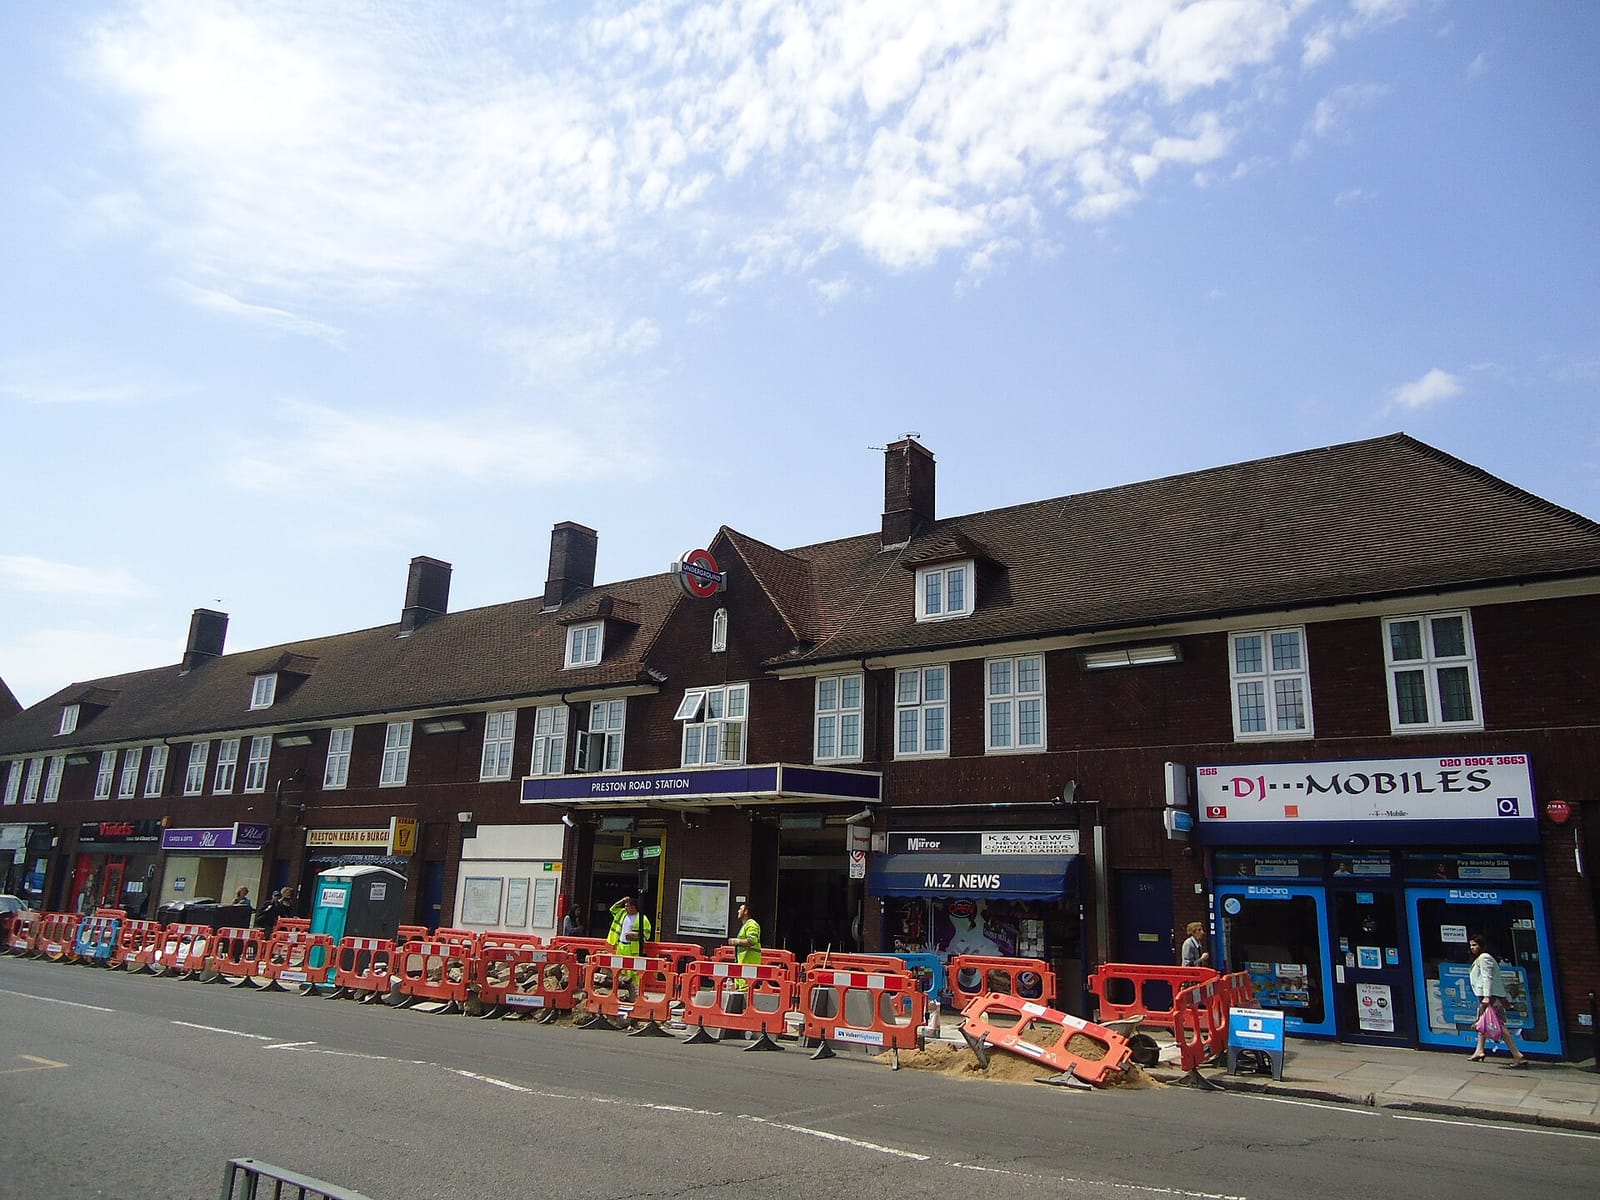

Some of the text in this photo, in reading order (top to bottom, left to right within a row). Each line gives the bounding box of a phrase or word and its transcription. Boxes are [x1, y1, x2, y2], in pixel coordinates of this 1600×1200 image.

[683, 563, 721, 582] UNDERGROUND
[1440, 756, 1526, 768] 020 8904 3663
[591, 778, 690, 792] PRESTON ROAD STATION
[1230, 768, 1492, 802] DJ MOBILES
[310, 832, 338, 841] PRESTON
[339, 832, 358, 841] KEBAB
[360, 832, 366, 841] &
[908, 838, 940, 850] Mirror
[924, 874, 1000, 889] M.Z. NEWS
[1255, 886, 1288, 895] Lebara
[1458, 890, 1497, 899] Lebara
[951, 903, 975, 914] OPEN
